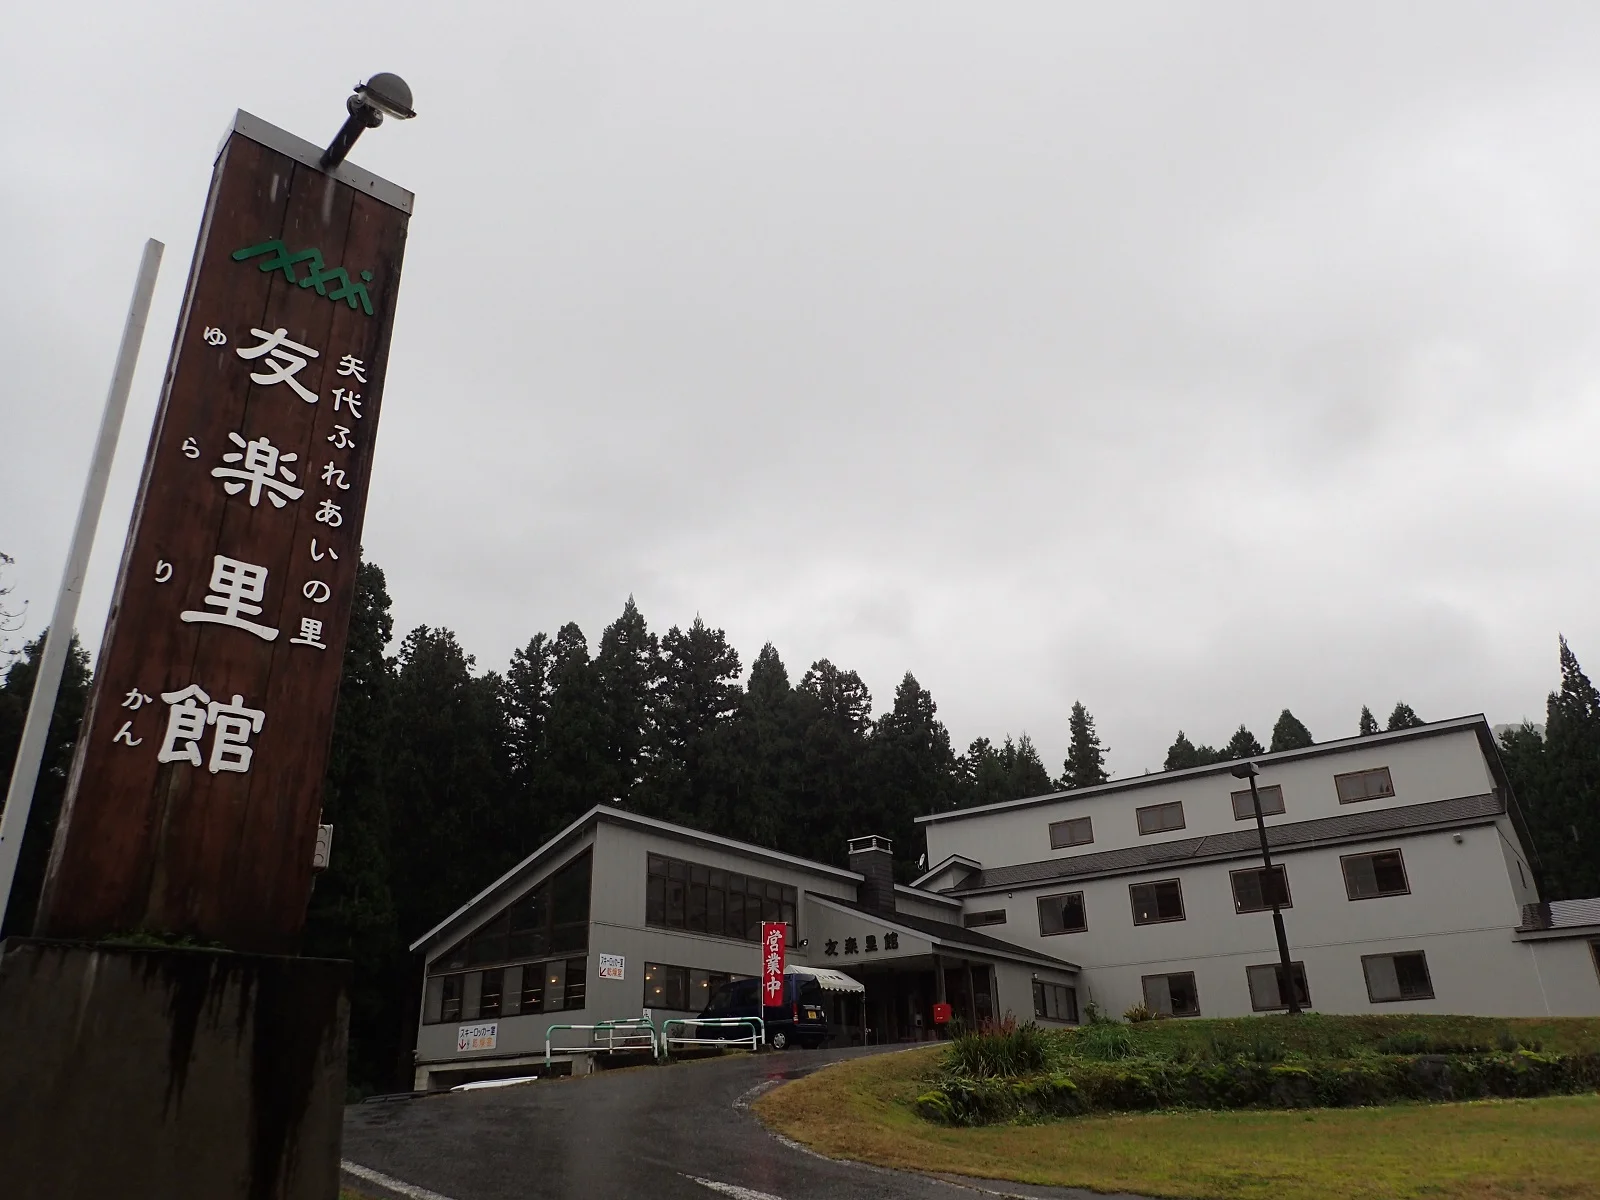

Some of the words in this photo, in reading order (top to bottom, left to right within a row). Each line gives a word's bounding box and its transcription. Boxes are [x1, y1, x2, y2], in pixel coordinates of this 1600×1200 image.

[158, 327, 320, 774] 友楽里館
[290, 354, 367, 650] 矢代ふれあいの里
[766, 929, 782, 999] 営業中
[824, 931, 899, 957] 友楽里館
